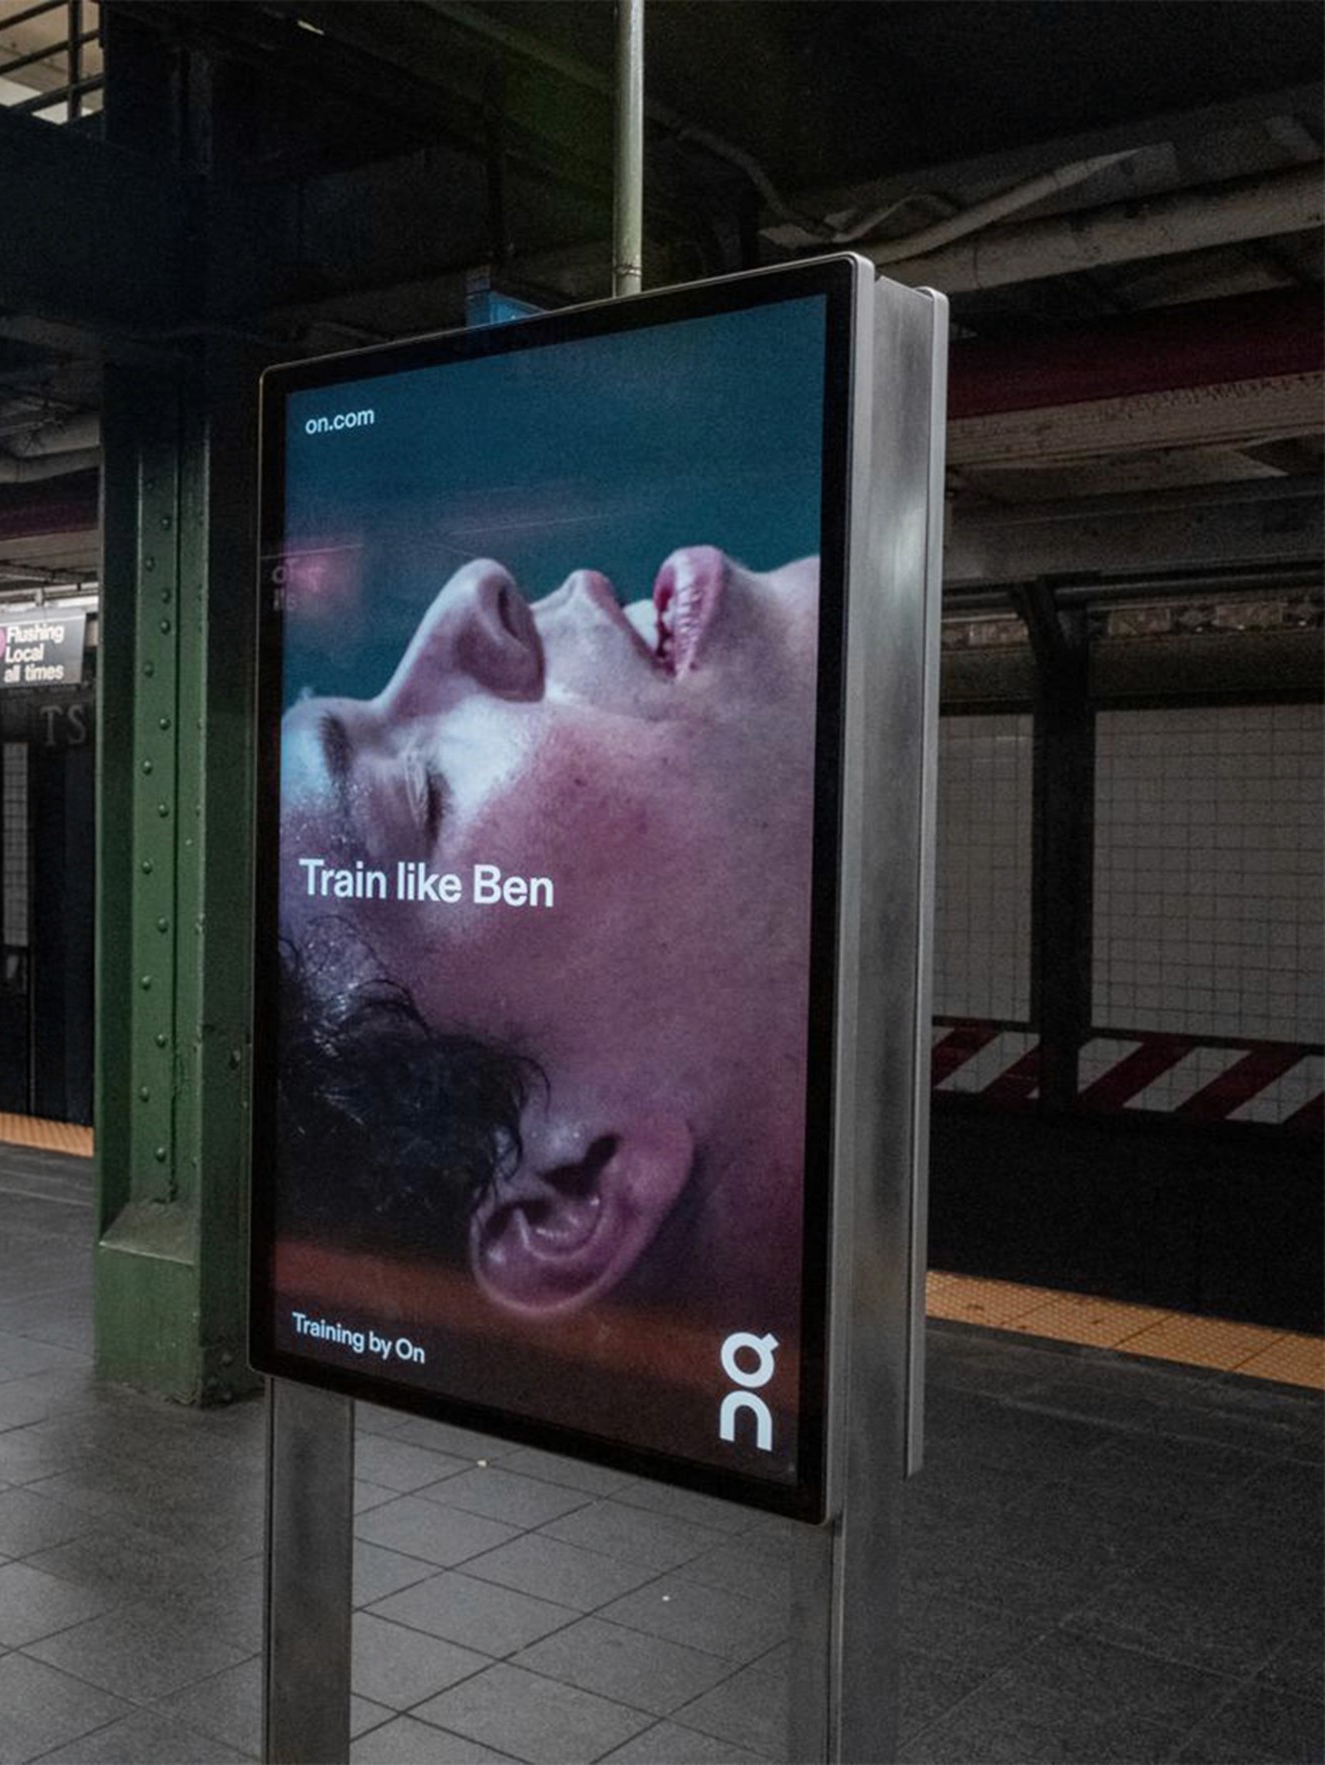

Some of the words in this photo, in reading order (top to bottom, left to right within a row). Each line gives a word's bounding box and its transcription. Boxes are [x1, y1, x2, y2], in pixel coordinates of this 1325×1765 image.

[304, 409, 375, 435] on.com
[6, 624, 65, 644] Flushing
[5, 644, 45, 663] Local
[4, 665, 21, 683] all
[25, 663, 65, 683] times
[39, 704, 87, 748] TS
[298, 857, 387, 899] Train
[396, 861, 463, 904] like
[473, 863, 555, 908] Ben
[291, 1311, 365, 1353] Training
[368, 1331, 393, 1360] by
[395, 1337, 425, 1364] On
